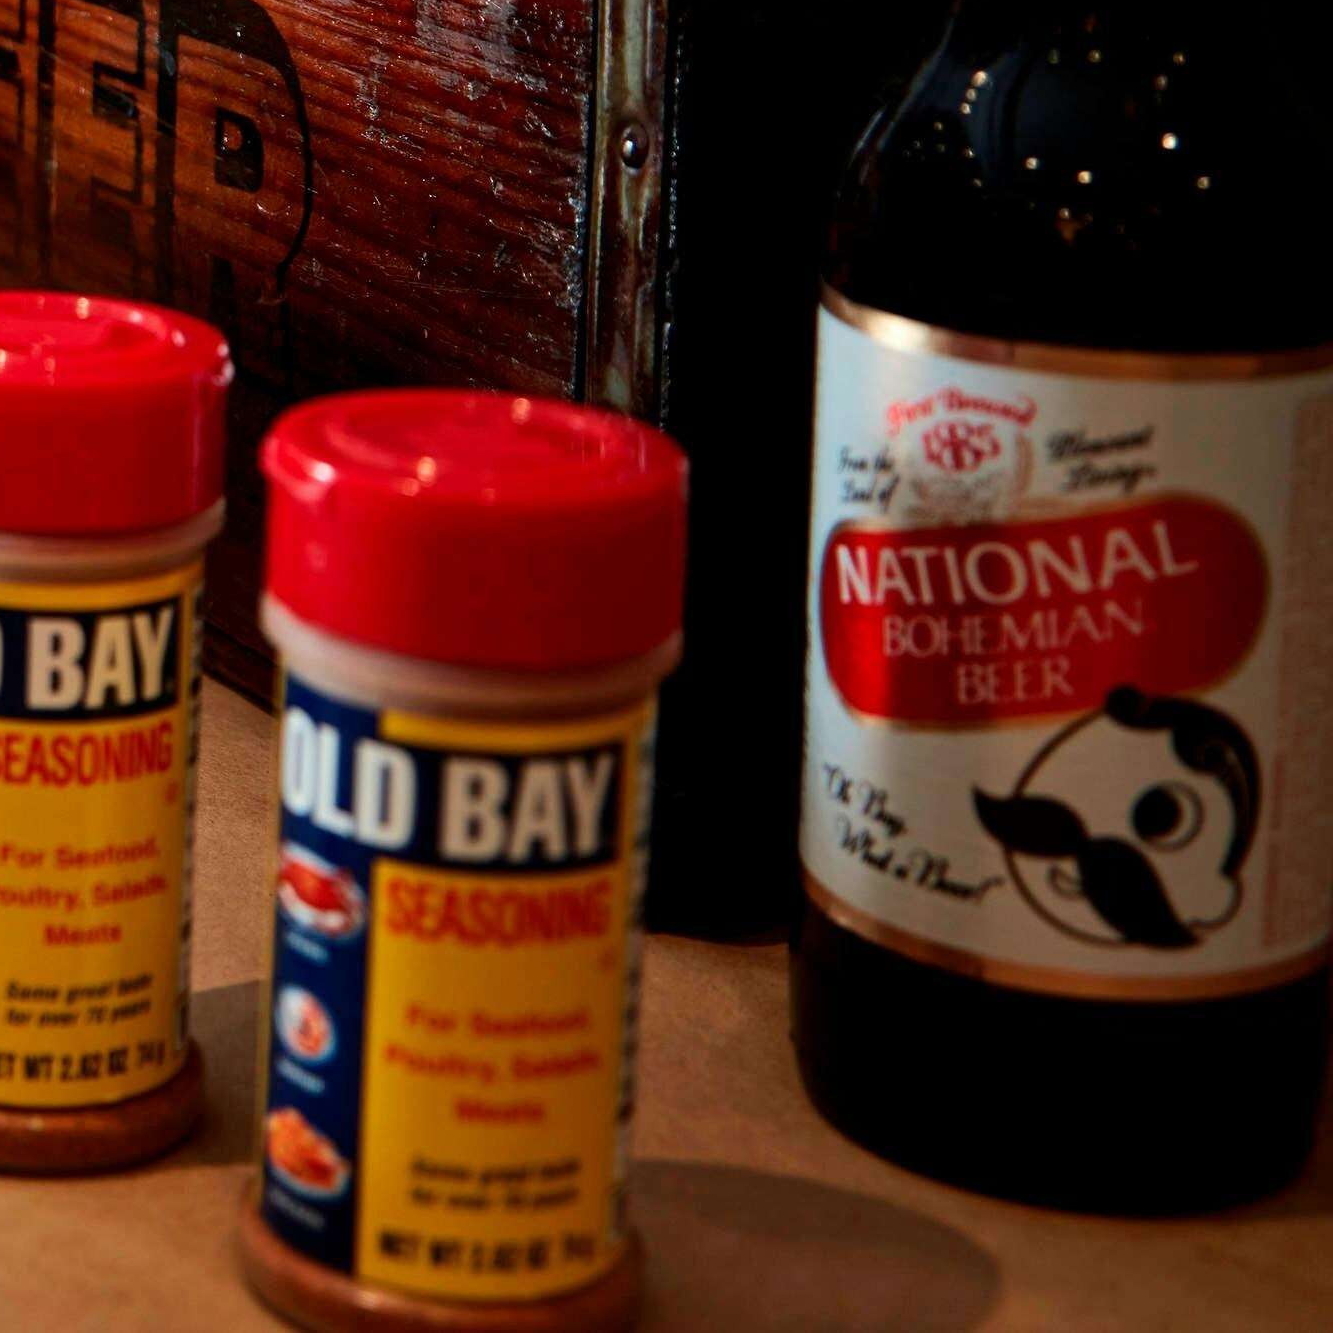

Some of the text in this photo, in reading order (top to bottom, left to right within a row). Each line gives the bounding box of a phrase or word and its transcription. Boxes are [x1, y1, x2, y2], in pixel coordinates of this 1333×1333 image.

[834, 519, 1199, 606] NATIONAL
[25, 604, 174, 712] BAY
[881, 598, 1148, 659] BOHEMIAN
[957, 656, 1075, 706] BEER
[280, 706, 617, 864] OLD BAY
[44, 922, 122, 949] Meats
[385, 877, 611, 948] SEASONING
